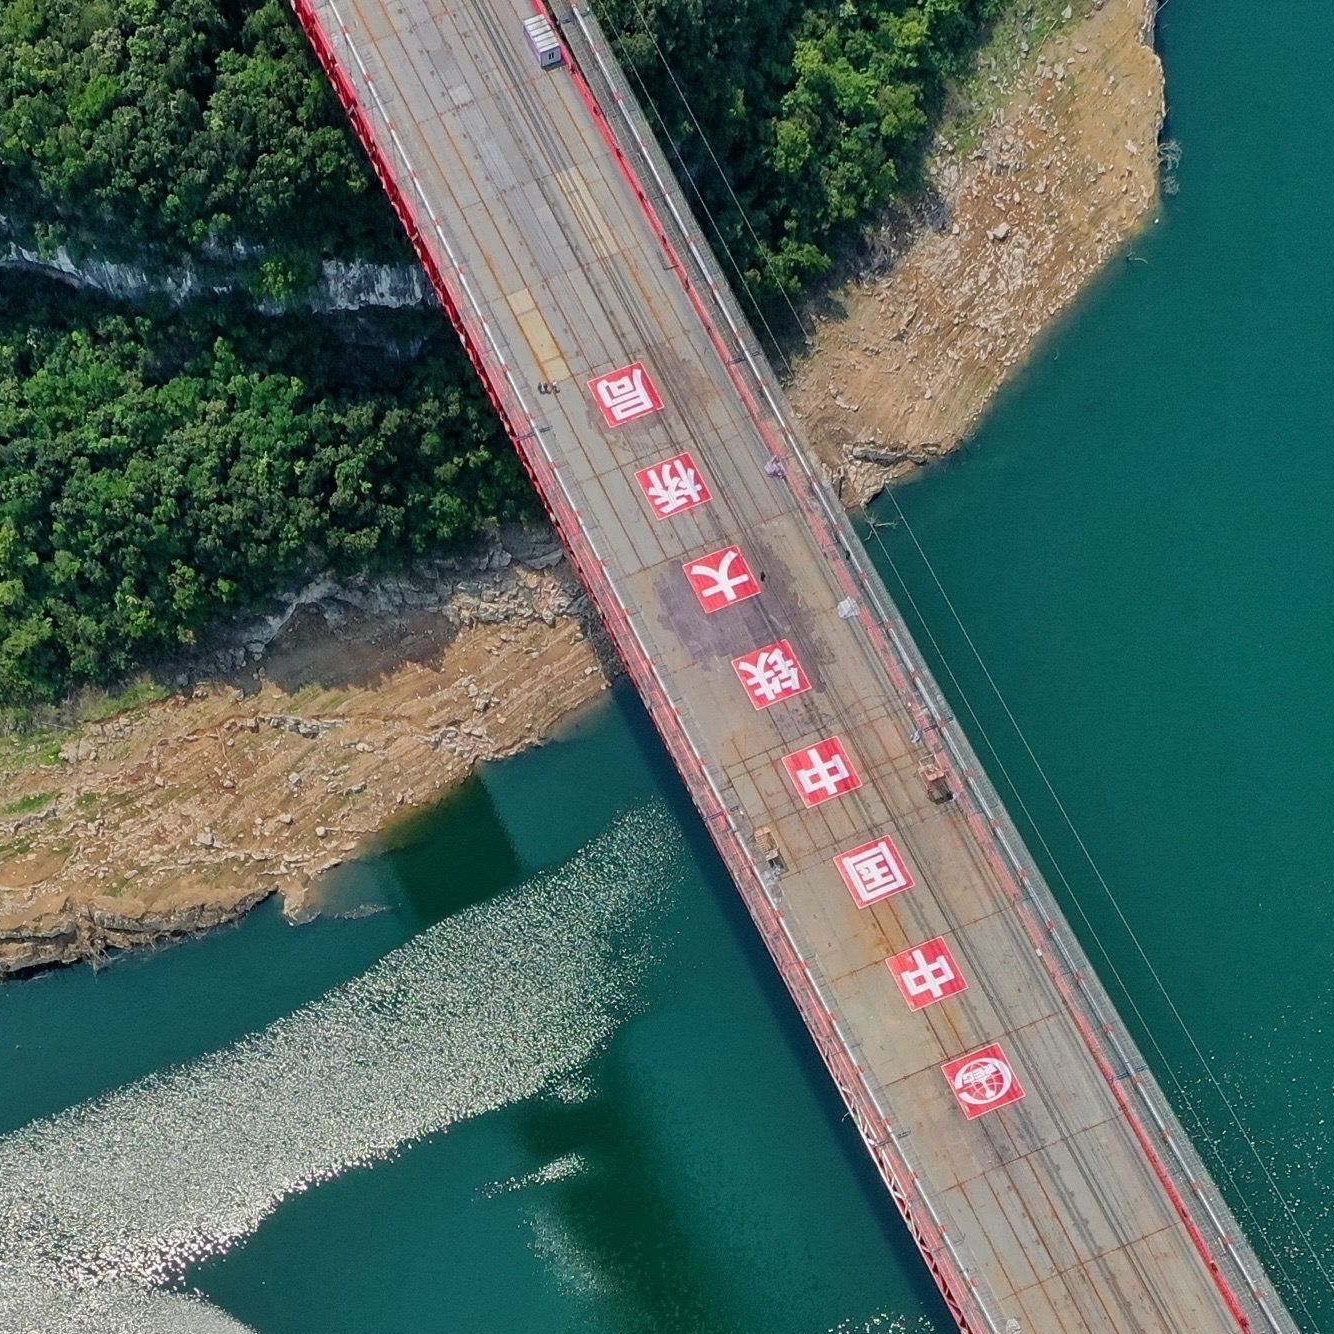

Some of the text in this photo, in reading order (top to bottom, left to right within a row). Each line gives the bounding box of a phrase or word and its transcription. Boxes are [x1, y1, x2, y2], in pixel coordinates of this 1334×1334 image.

[595, 367, 956, 999] 中国中铁大桥局
